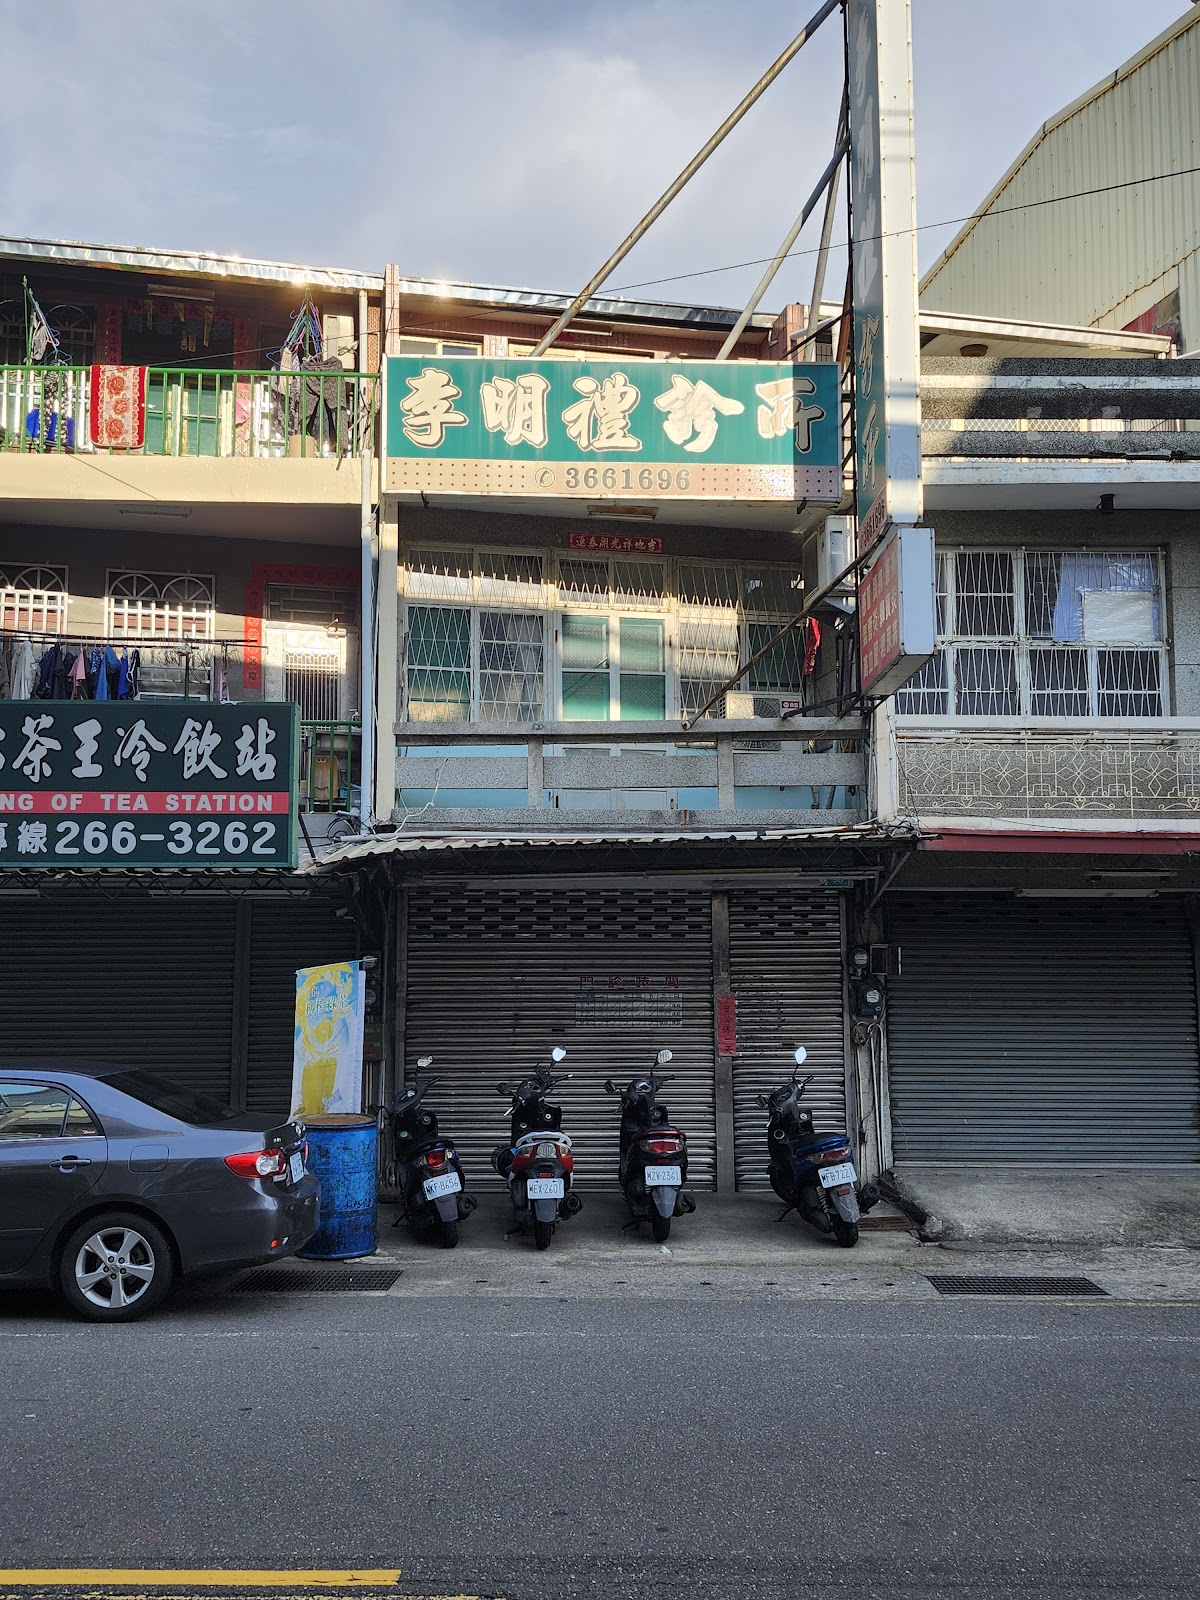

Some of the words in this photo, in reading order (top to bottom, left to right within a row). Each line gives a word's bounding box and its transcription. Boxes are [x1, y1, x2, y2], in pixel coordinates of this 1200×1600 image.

[400, 367, 826, 453] 李明禮診所
[564, 467, 691, 491] 3661696
[0, 714, 277, 783] 茶王冷飲站
[51, 794, 83, 811] OF
[100, 794, 149, 811] TEA
[165, 794, 273, 812] STATION
